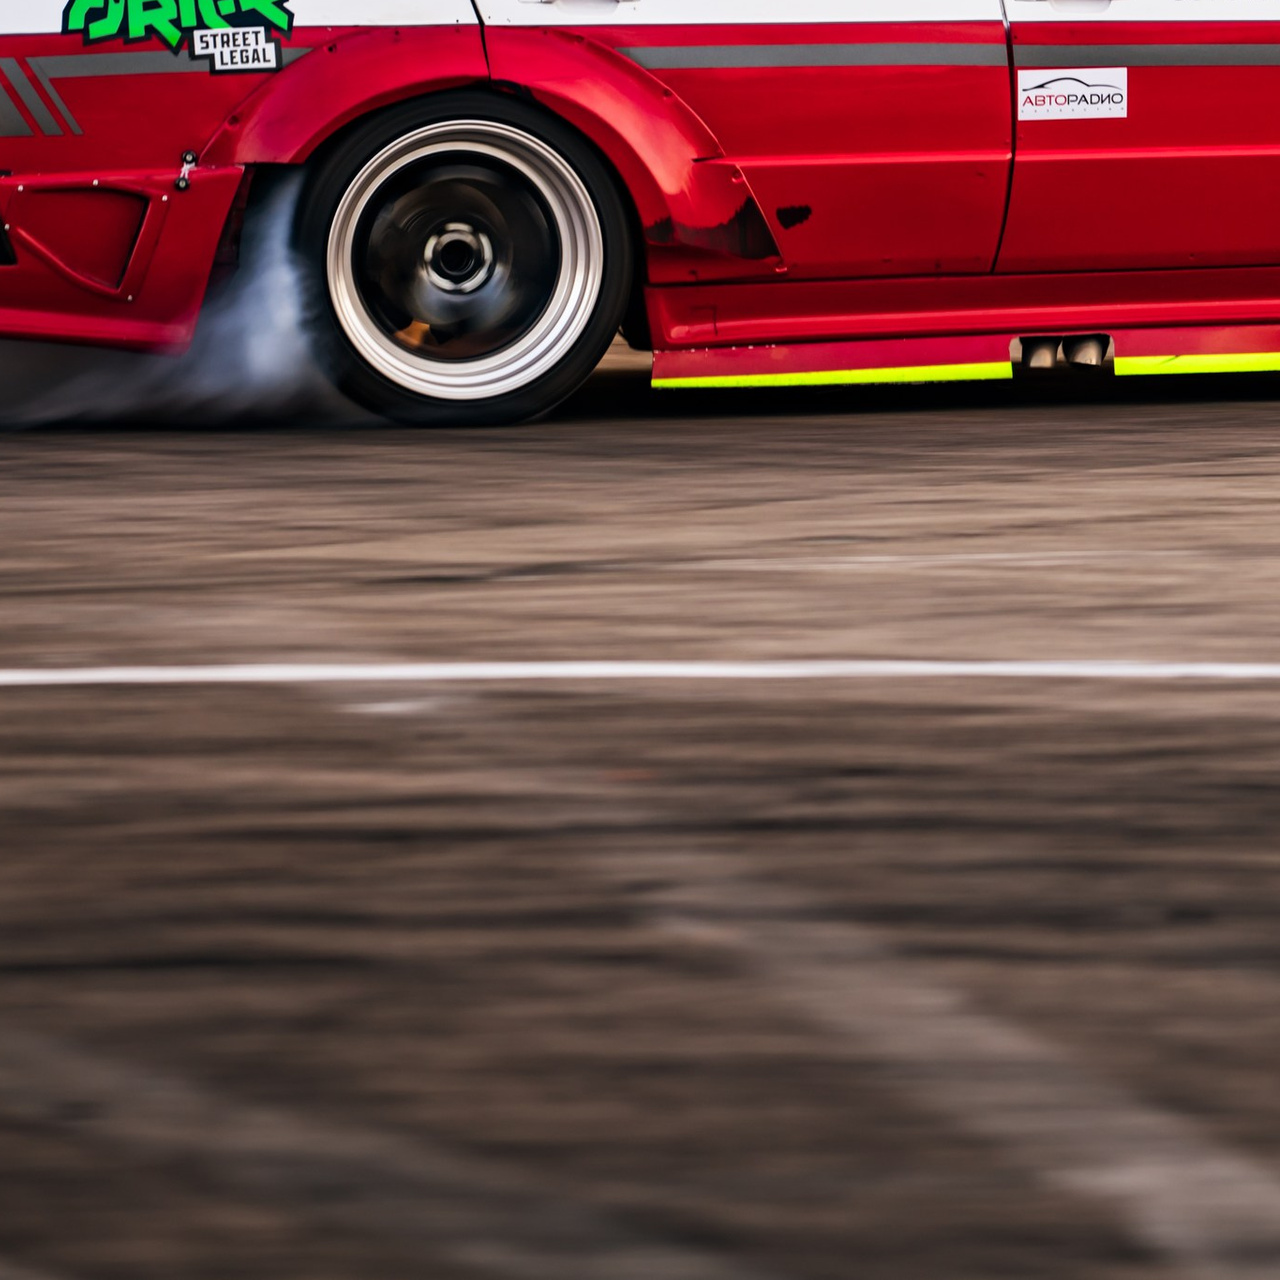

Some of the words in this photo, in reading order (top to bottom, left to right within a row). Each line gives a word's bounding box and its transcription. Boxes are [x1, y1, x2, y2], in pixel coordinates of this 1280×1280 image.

[199, 30, 261, 50] STREET
[219, 46, 271, 66] LEGAL
[1022, 92, 1124, 107] АВТОРАДИО
